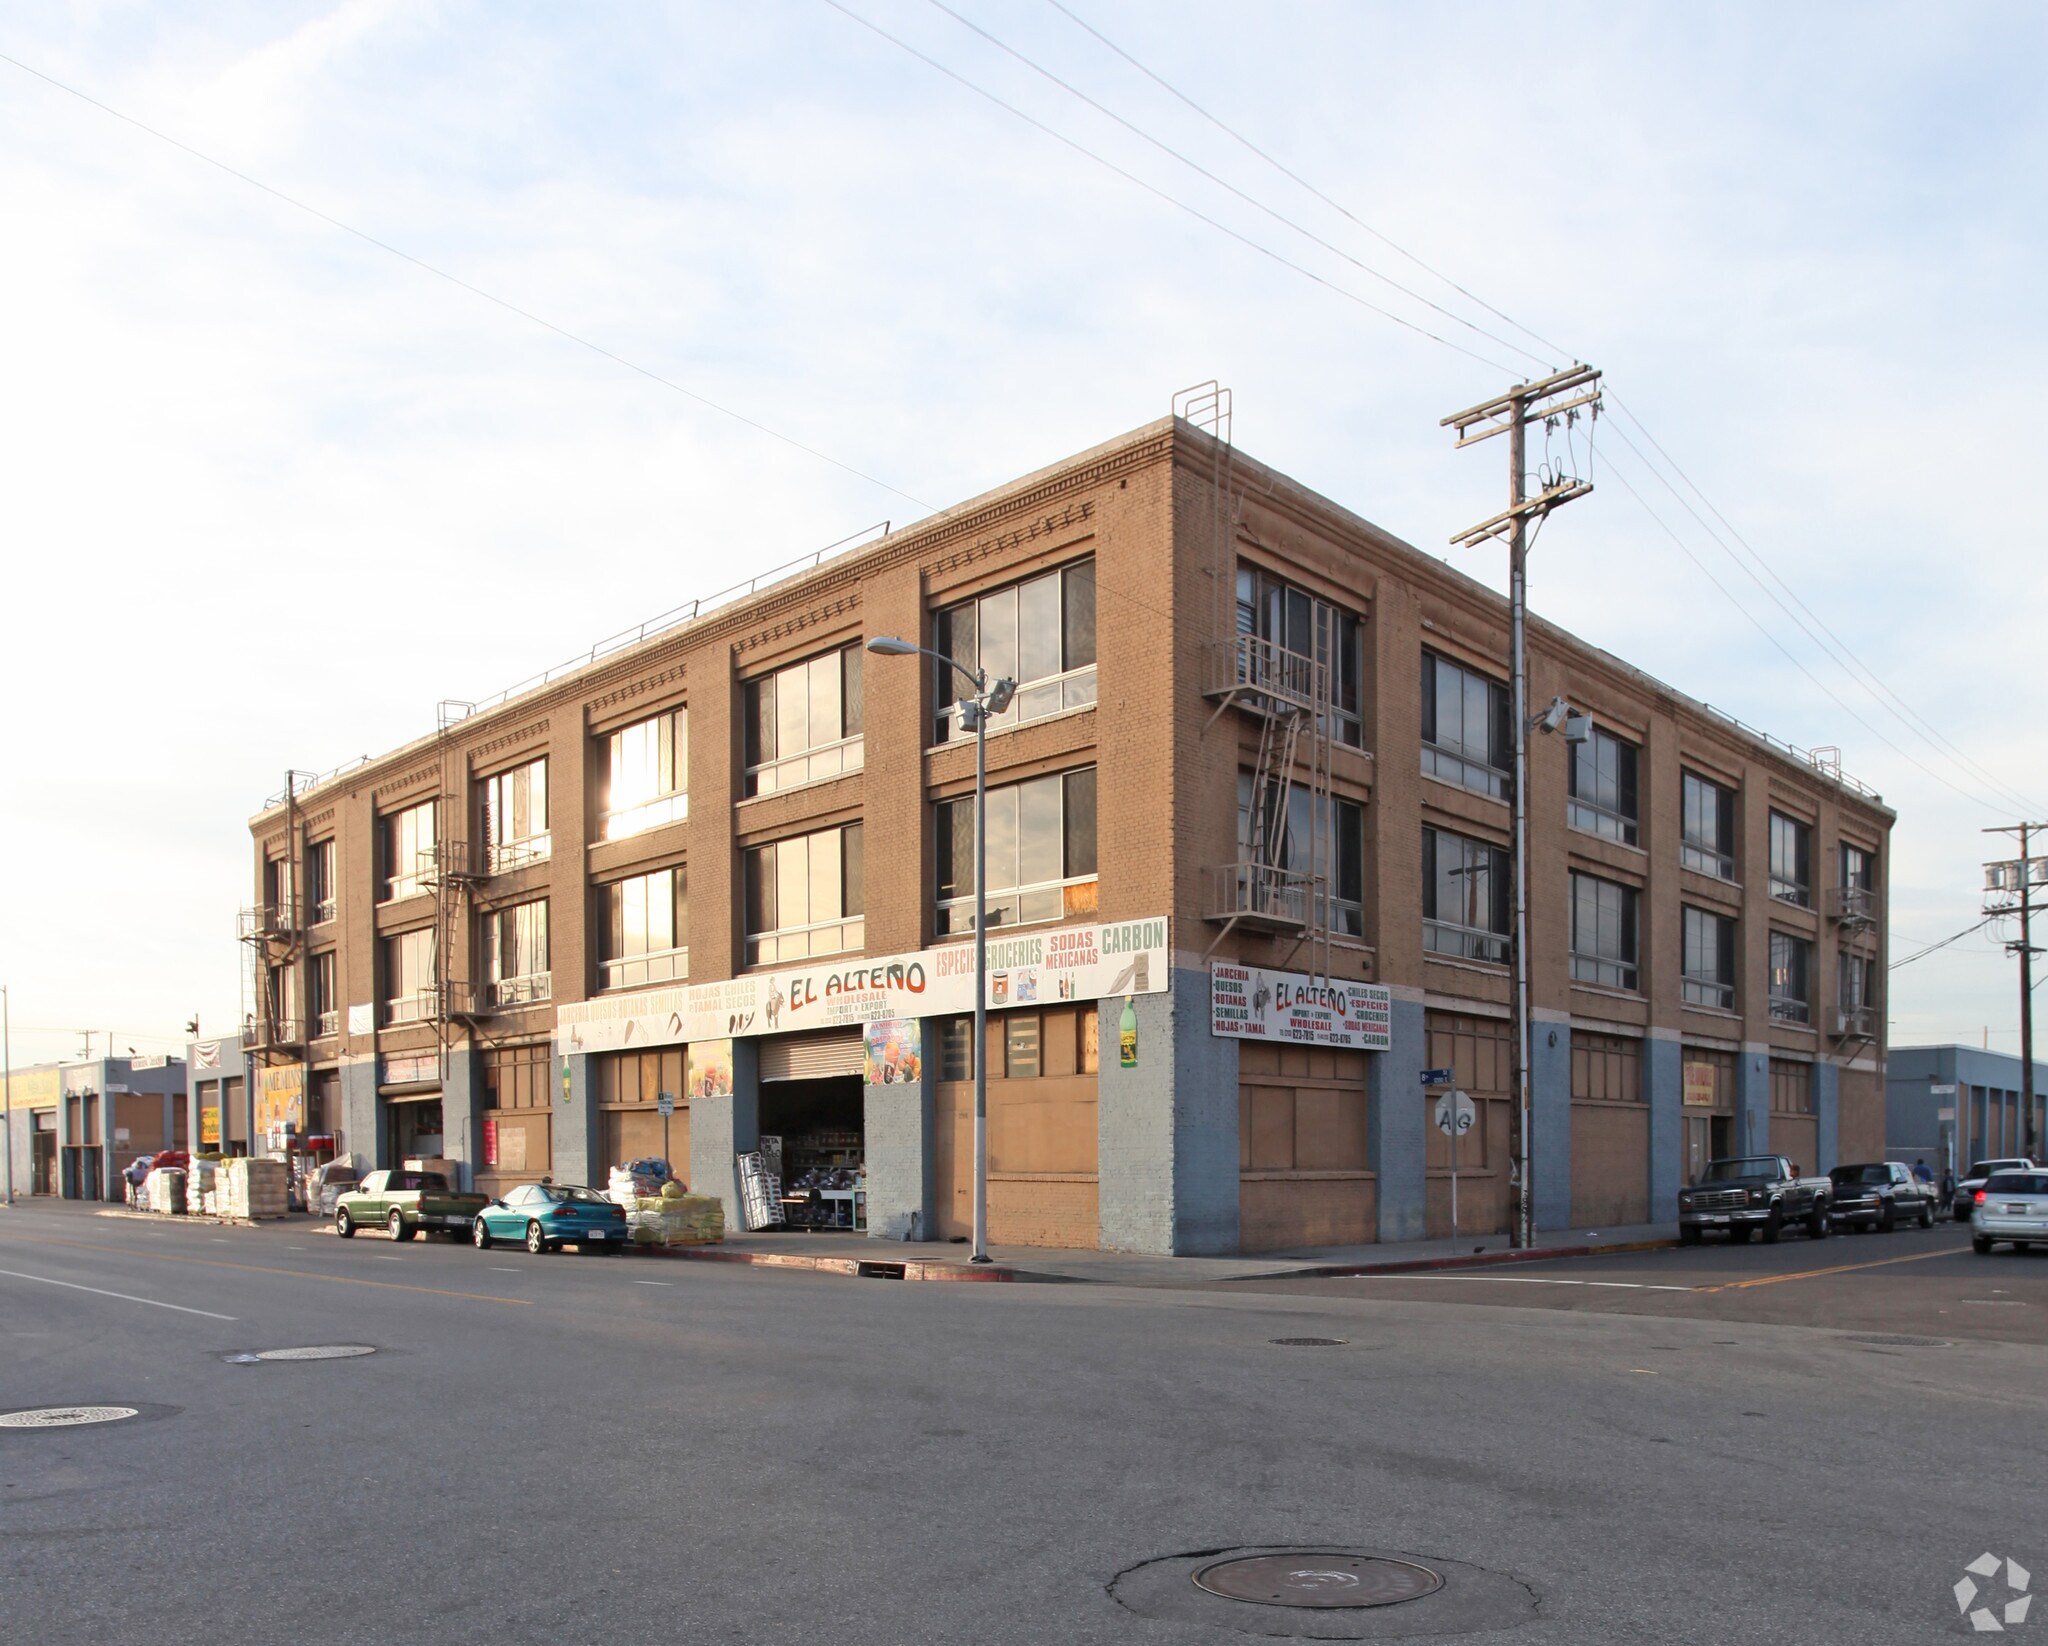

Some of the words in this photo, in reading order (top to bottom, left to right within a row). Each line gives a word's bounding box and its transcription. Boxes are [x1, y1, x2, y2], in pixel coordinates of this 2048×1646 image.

[1050, 931, 1093, 952] SODAS
[1102, 921, 1164, 954] CARBON
[936, 949, 976, 977] ESPECIE
[985, 938, 1042, 970] GROCERIES
[1046, 949, 1099, 970] MEXICANAS
[1215, 967, 1249, 981] JARCERIA
[689, 985, 721, 1001] HOJAS
[724, 981, 756, 997] CHILES
[1215, 980, 1243, 993] QUESOS
[1348, 987, 1368, 999] CHILES
[1369, 989, 1388, 1001] SECOS
[725, 994, 756, 1009] SECOS
[790, 978, 817, 1011] EL
[826, 990, 887, 1006] WHOLESALE
[1215, 993, 1247, 1007] BOTANAS
[1276, 983, 1292, 1012] EL
[618, 996, 648, 1019] BOTANAS
[694, 999, 723, 1014] TAMAL
[826, 1005, 852, 1015] IMPORT
[861, 1001, 887, 1012] EXPORT
[1351, 999, 1388, 1011] ESPECIES
[1215, 1007, 1248, 1020] SEMILLAS
[1292, 1009, 1310, 1018] IMPORT
[1315, 1011, 1332, 1020] EXPORT
[1356, 1010, 1389, 1023] GROCERIES
[1215, 1020, 1239, 1032] HOJAS
[1244, 1022, 1266, 1035] TAMAL
[1290, 1018, 1332, 1031] WHOLESALE
[1344, 1021, 1361, 1031] SODAS
[1361, 1022, 1389, 1034] MEXICANAS
[1364, 1034, 1389, 1046] CARBON
